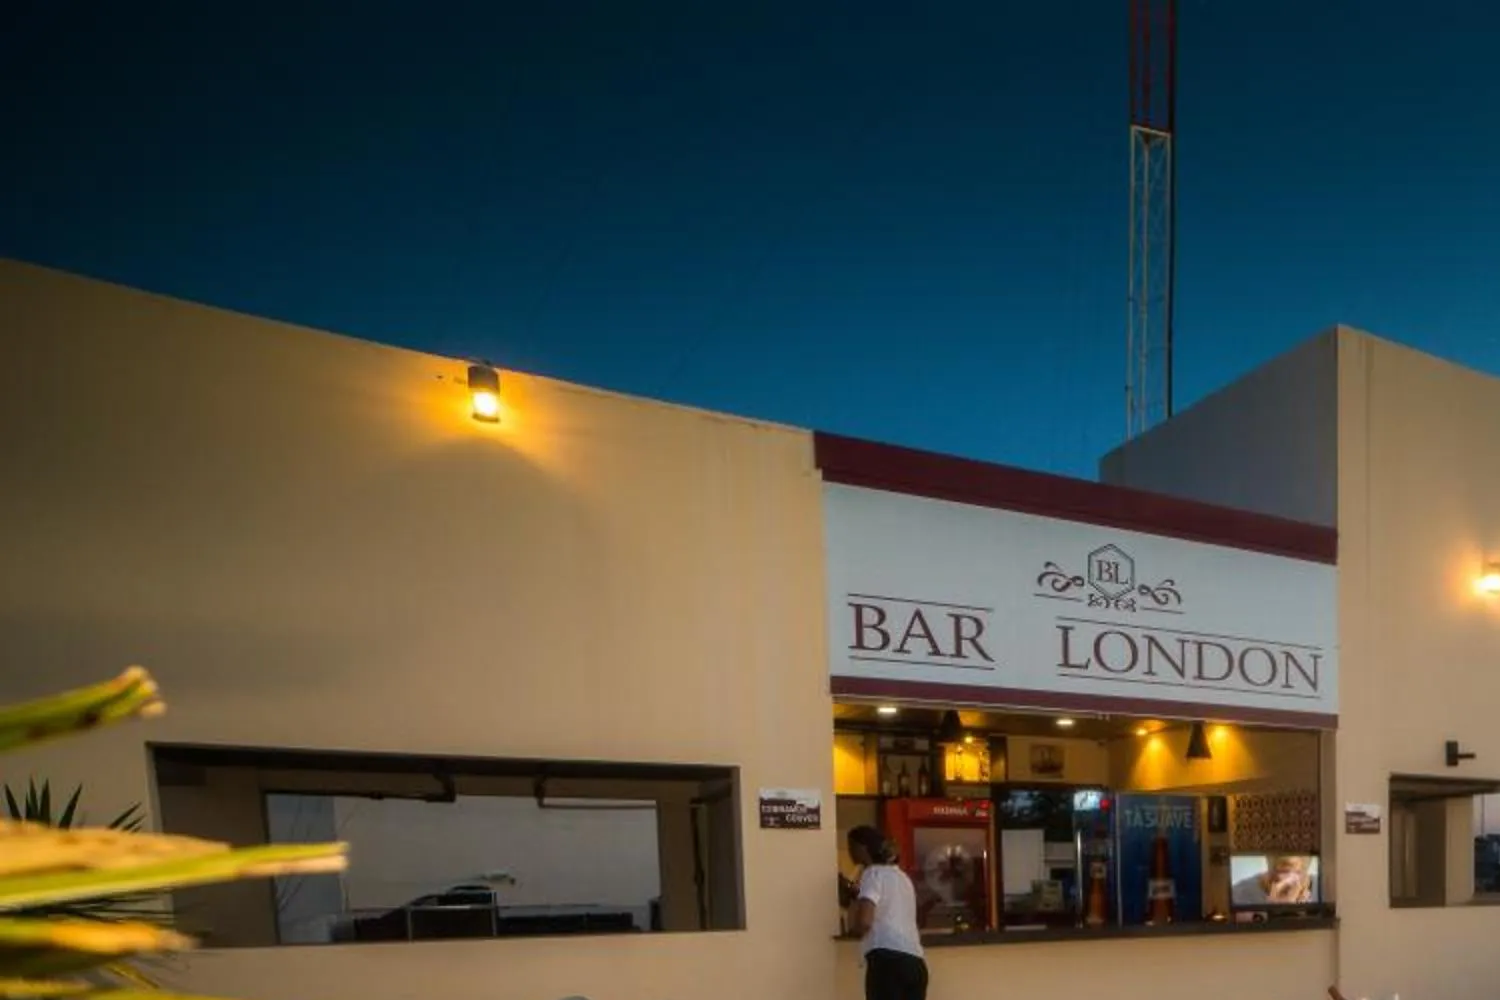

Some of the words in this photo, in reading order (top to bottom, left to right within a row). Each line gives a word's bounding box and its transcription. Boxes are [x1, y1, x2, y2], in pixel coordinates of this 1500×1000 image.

[1095, 559, 1129, 585] BL
[847, 602, 995, 662] BAR
[1055, 625, 1323, 692] LONDON
